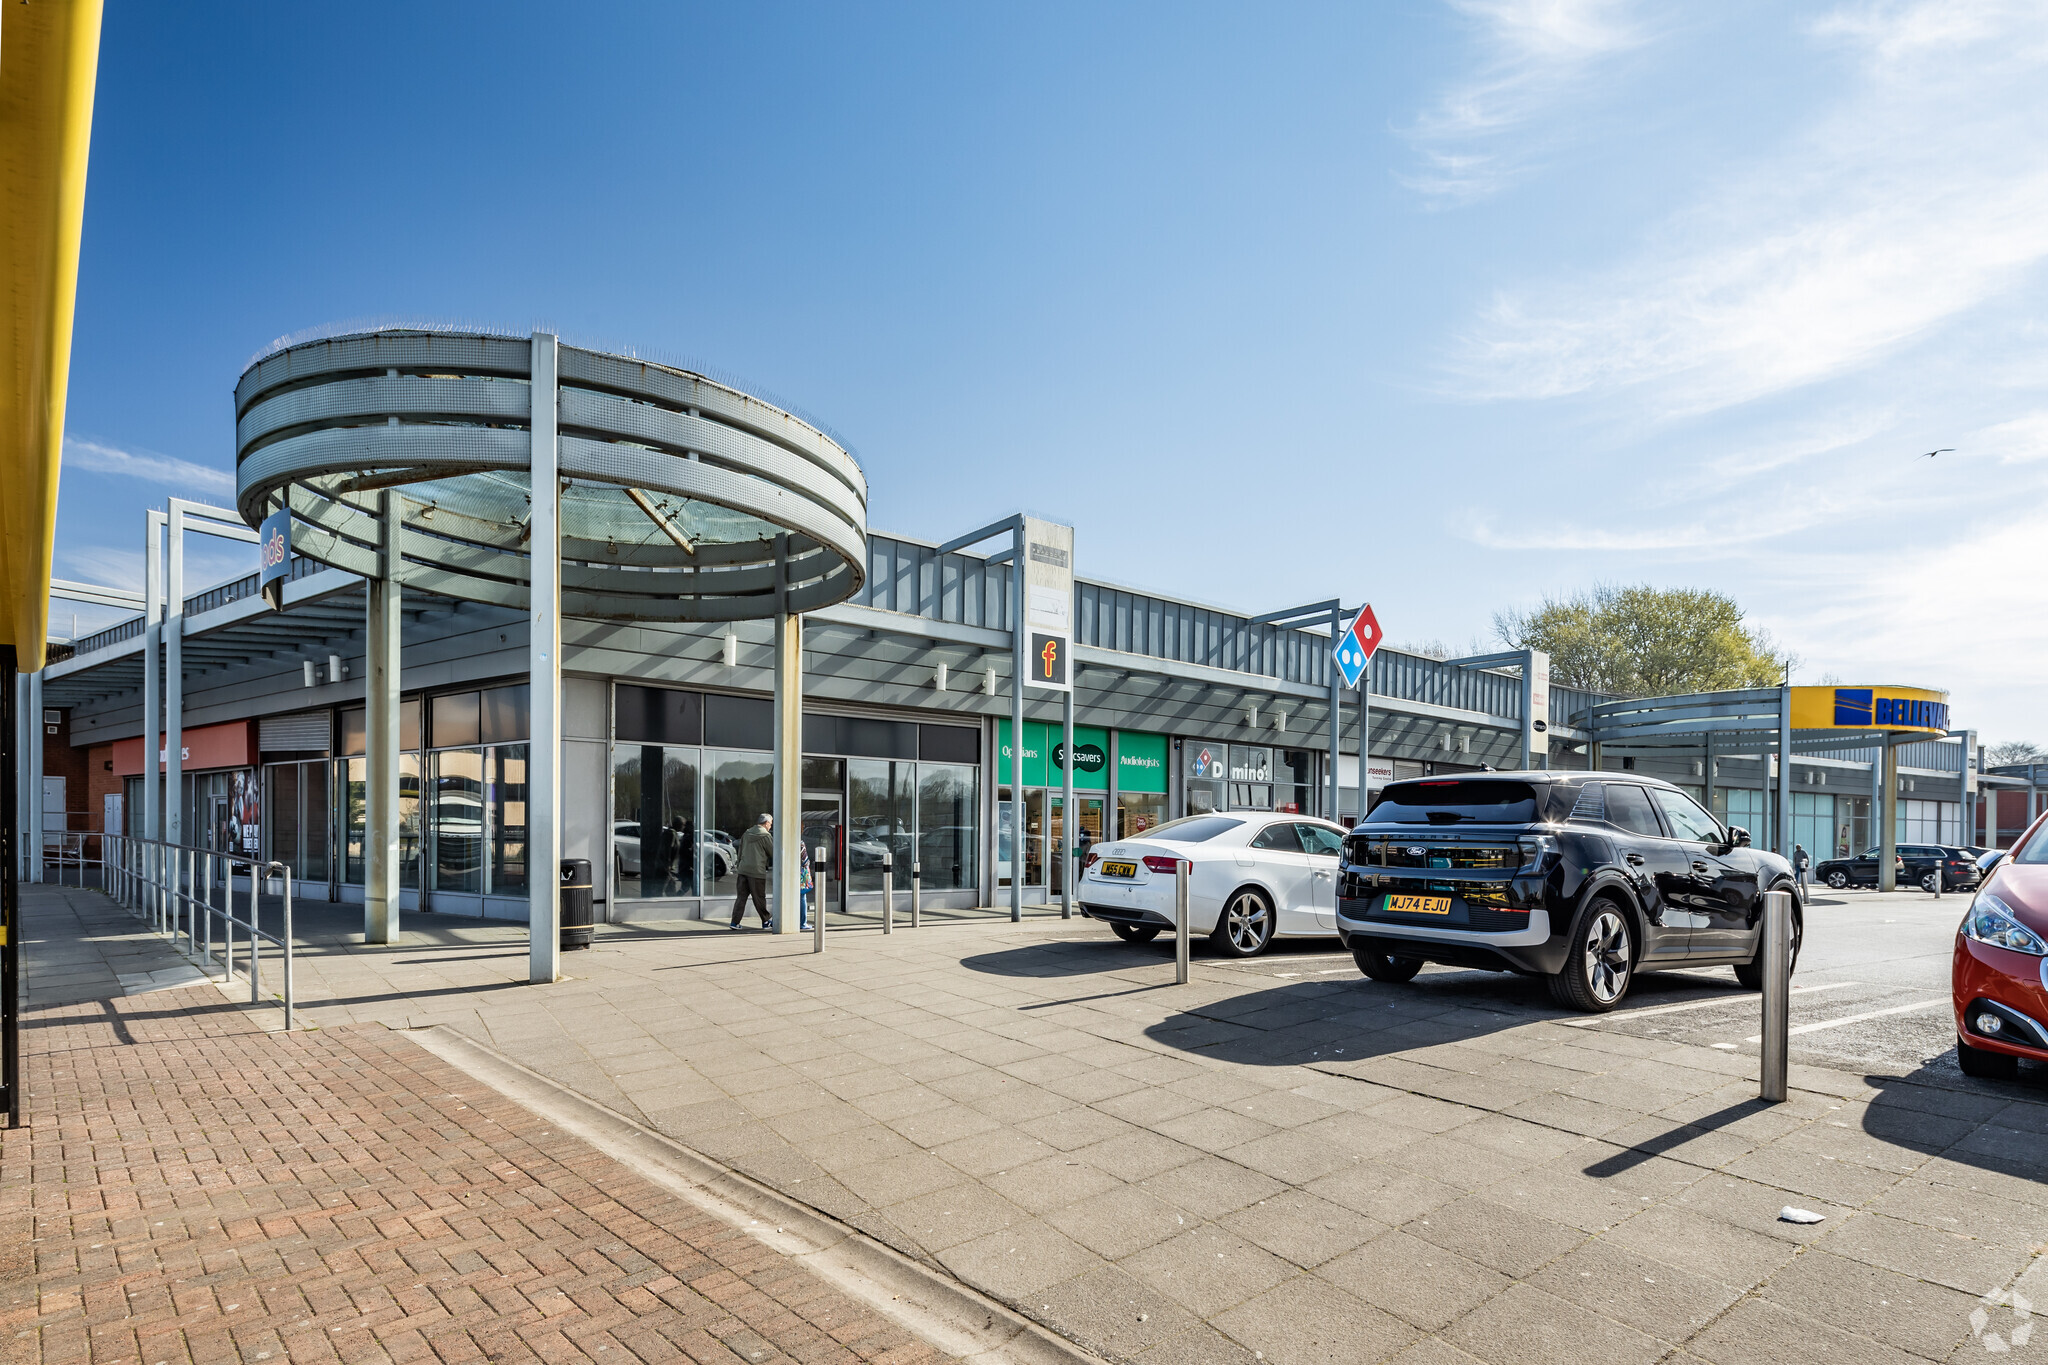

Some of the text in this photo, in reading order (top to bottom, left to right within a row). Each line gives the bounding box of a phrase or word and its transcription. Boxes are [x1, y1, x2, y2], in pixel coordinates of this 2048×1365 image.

[1042, 640, 1056, 678] f
[1002, 745, 1038, 759] Opians
[1058, 749, 1101, 763] Scsavers
[1120, 755, 1160, 769] Audiologists
[1212, 761, 1268, 781] Dmino'
[1390, 895, 1449, 913] MJ74 EJU
